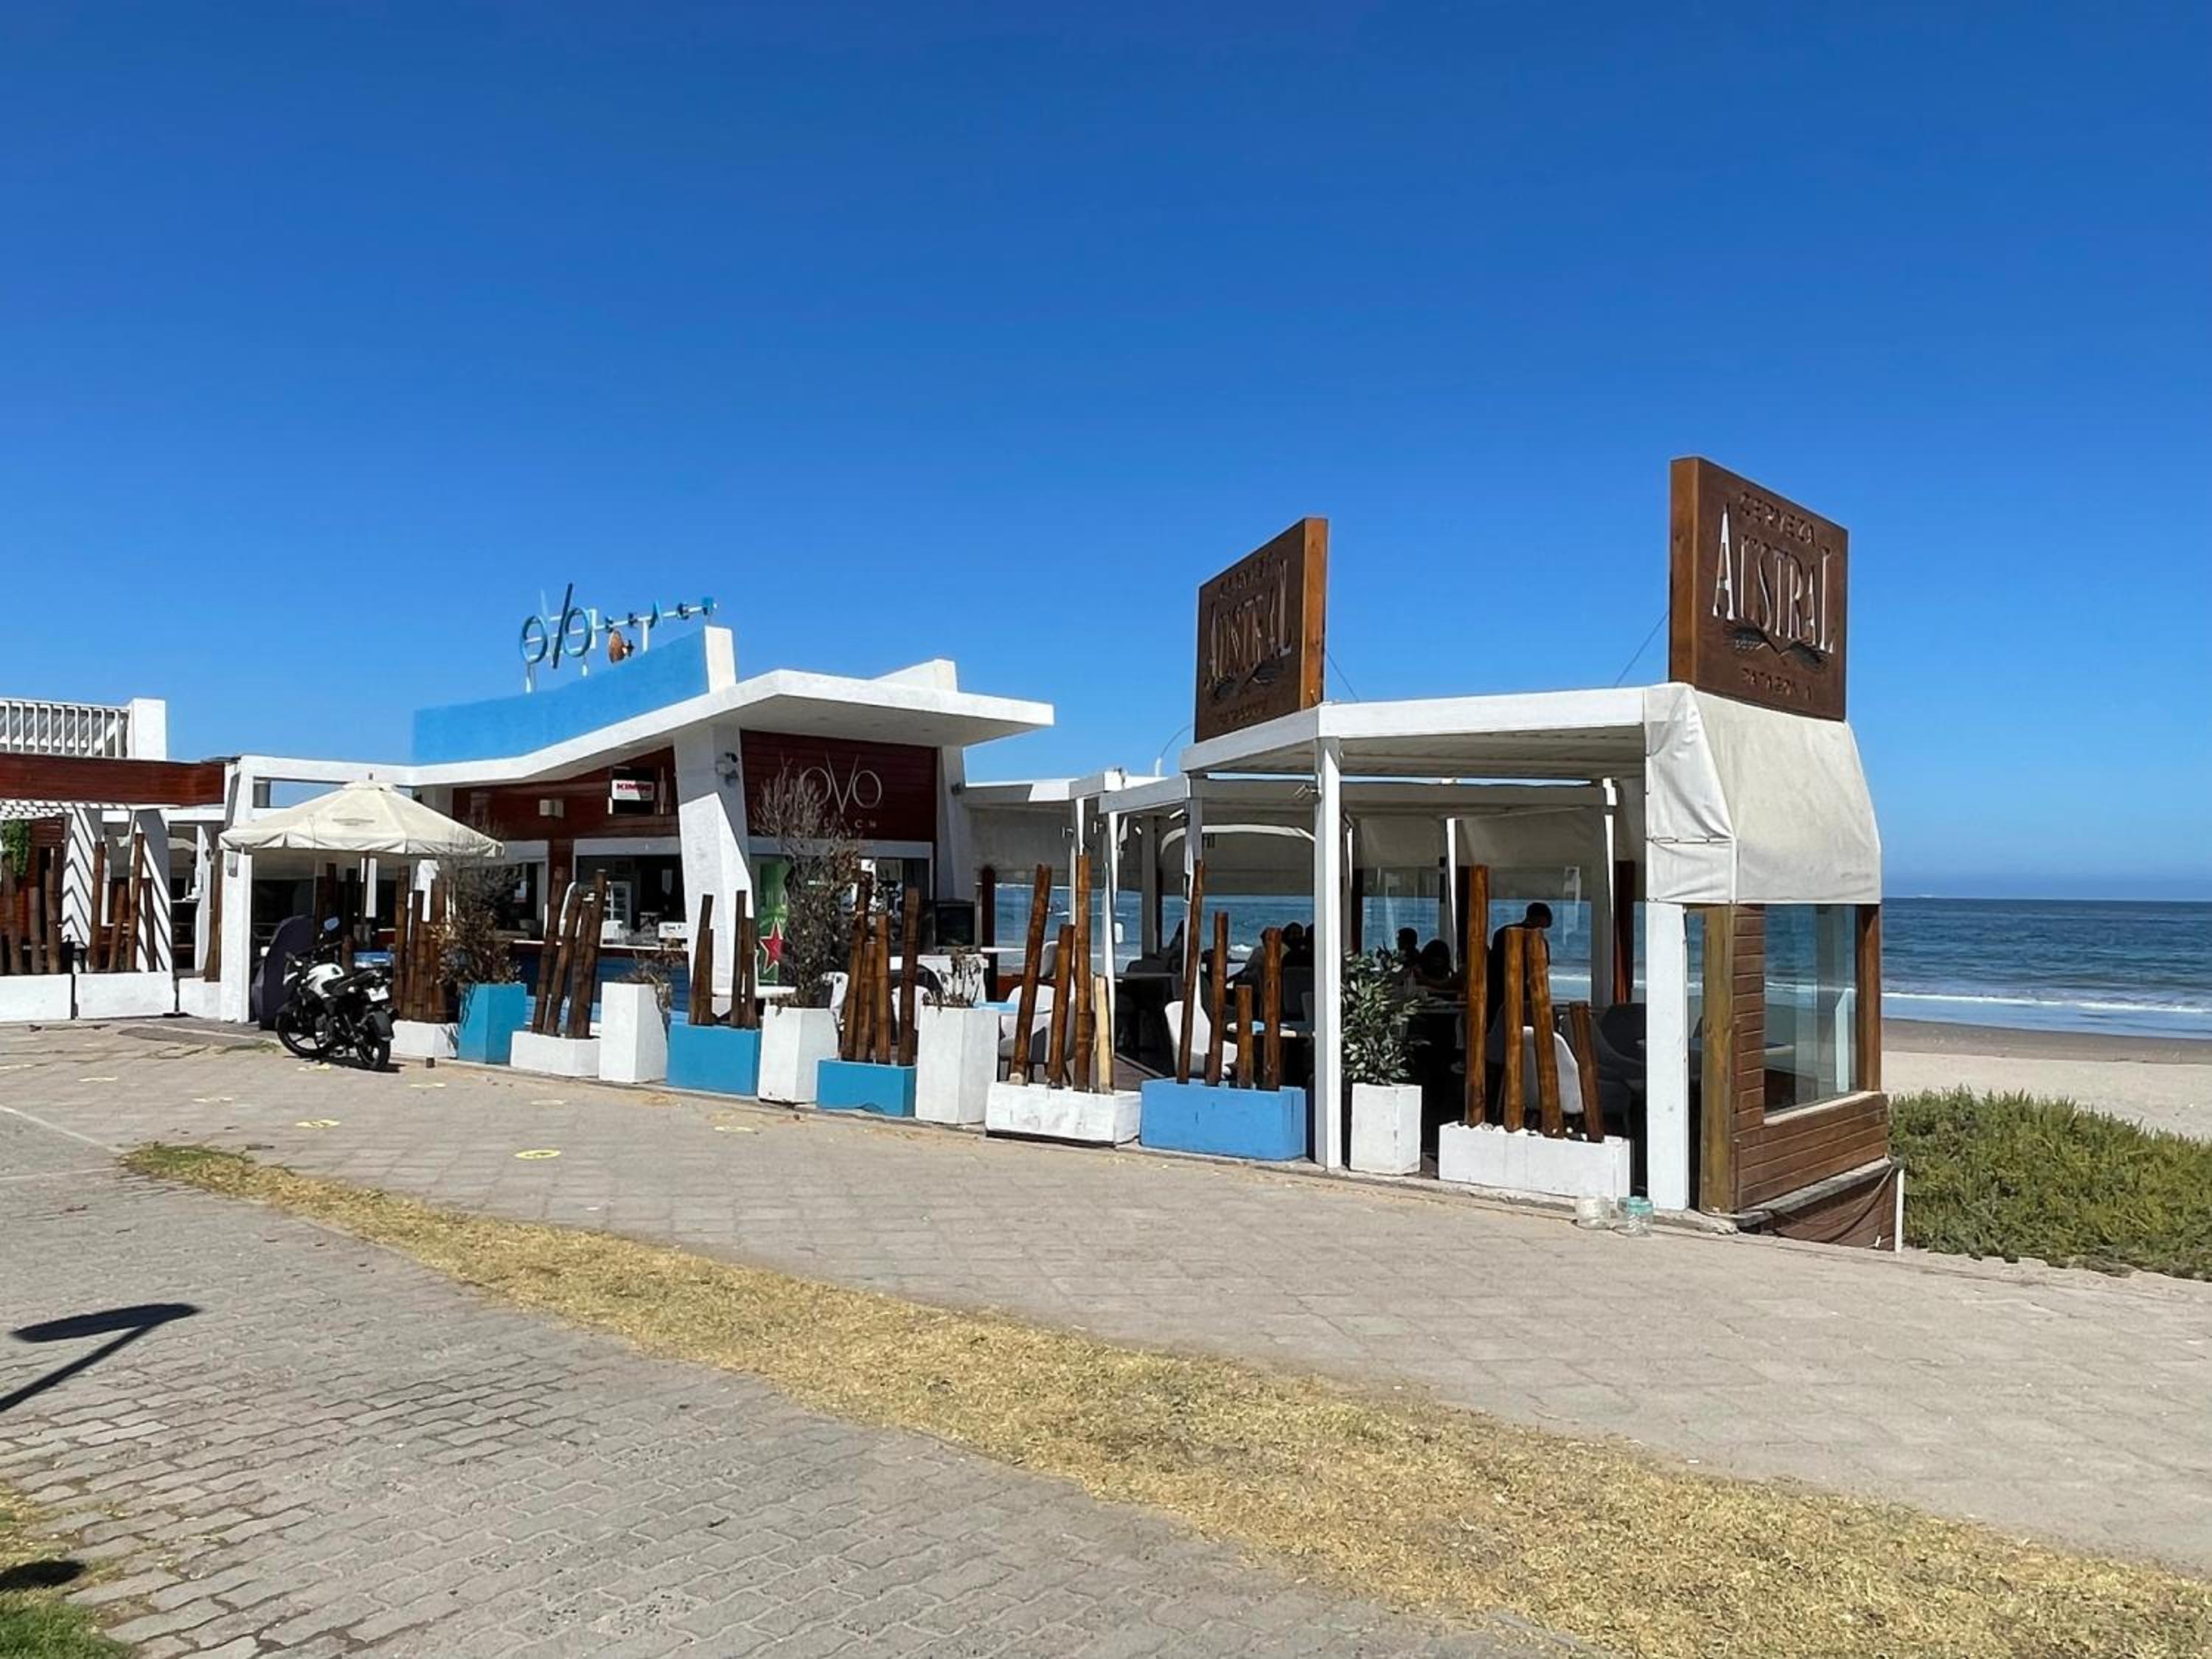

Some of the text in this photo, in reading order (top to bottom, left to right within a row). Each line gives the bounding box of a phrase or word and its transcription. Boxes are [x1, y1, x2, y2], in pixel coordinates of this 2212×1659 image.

[1739, 492, 1816, 548] CERVEZA
[1712, 501, 1834, 654] AUSTRAL
[800, 749, 883, 813] OVO
